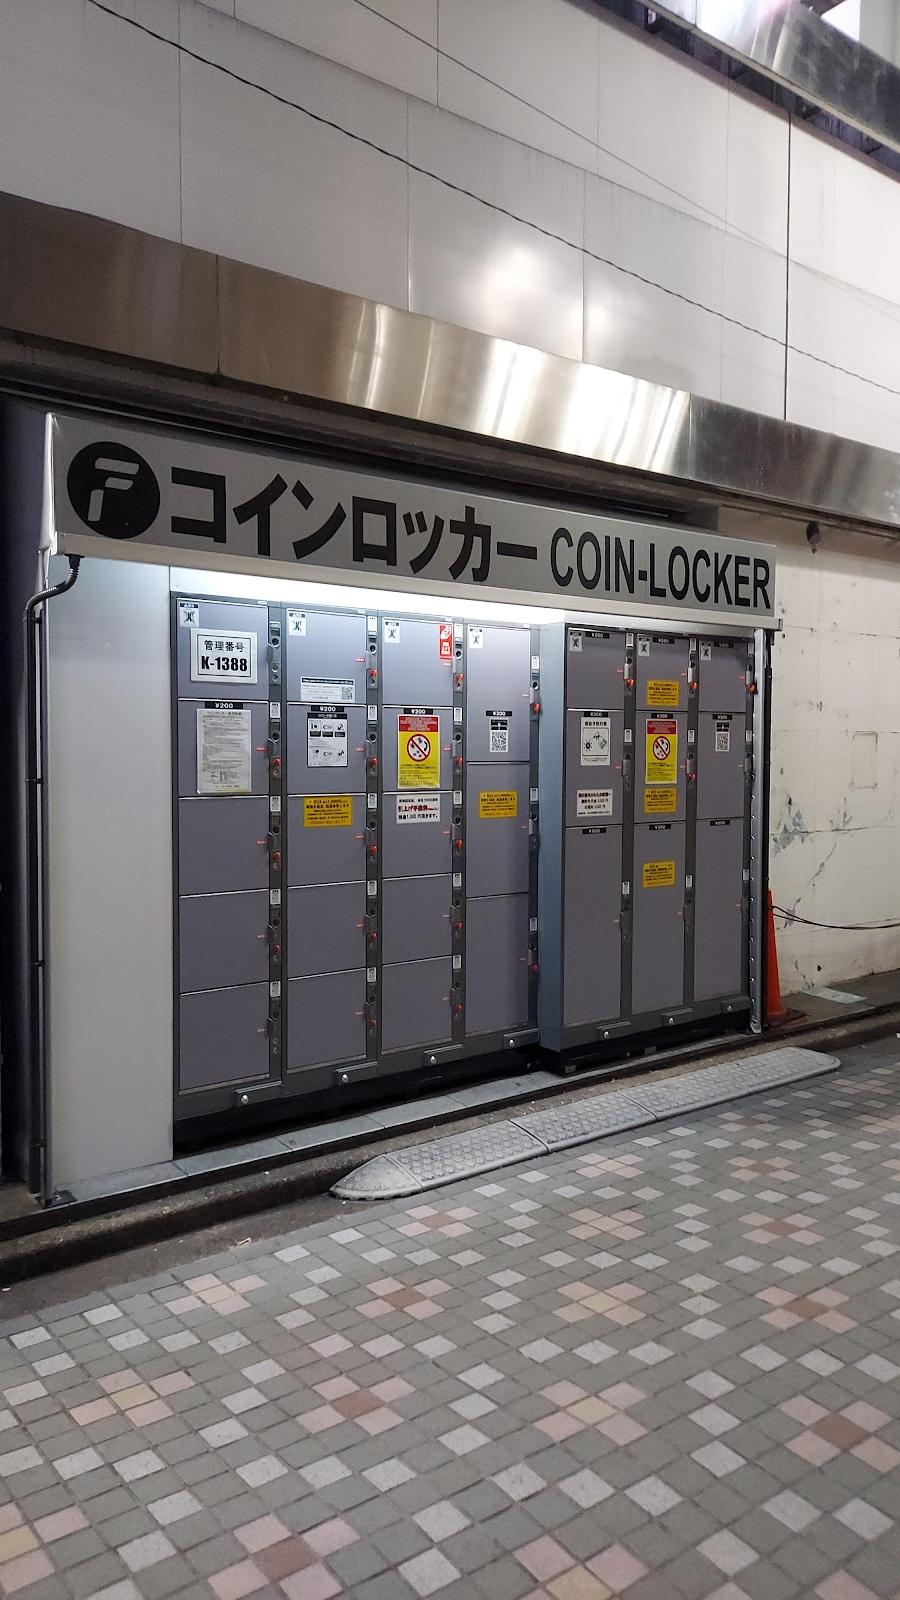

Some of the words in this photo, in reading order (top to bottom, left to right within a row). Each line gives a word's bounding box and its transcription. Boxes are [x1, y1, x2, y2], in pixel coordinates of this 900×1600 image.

[171, 466, 538, 583] コインロッカー
[550, 527, 771, 609] COIN-LOCKER
[204, 640, 245, 652] 管理番号
[201, 656, 248, 671] K-1388
